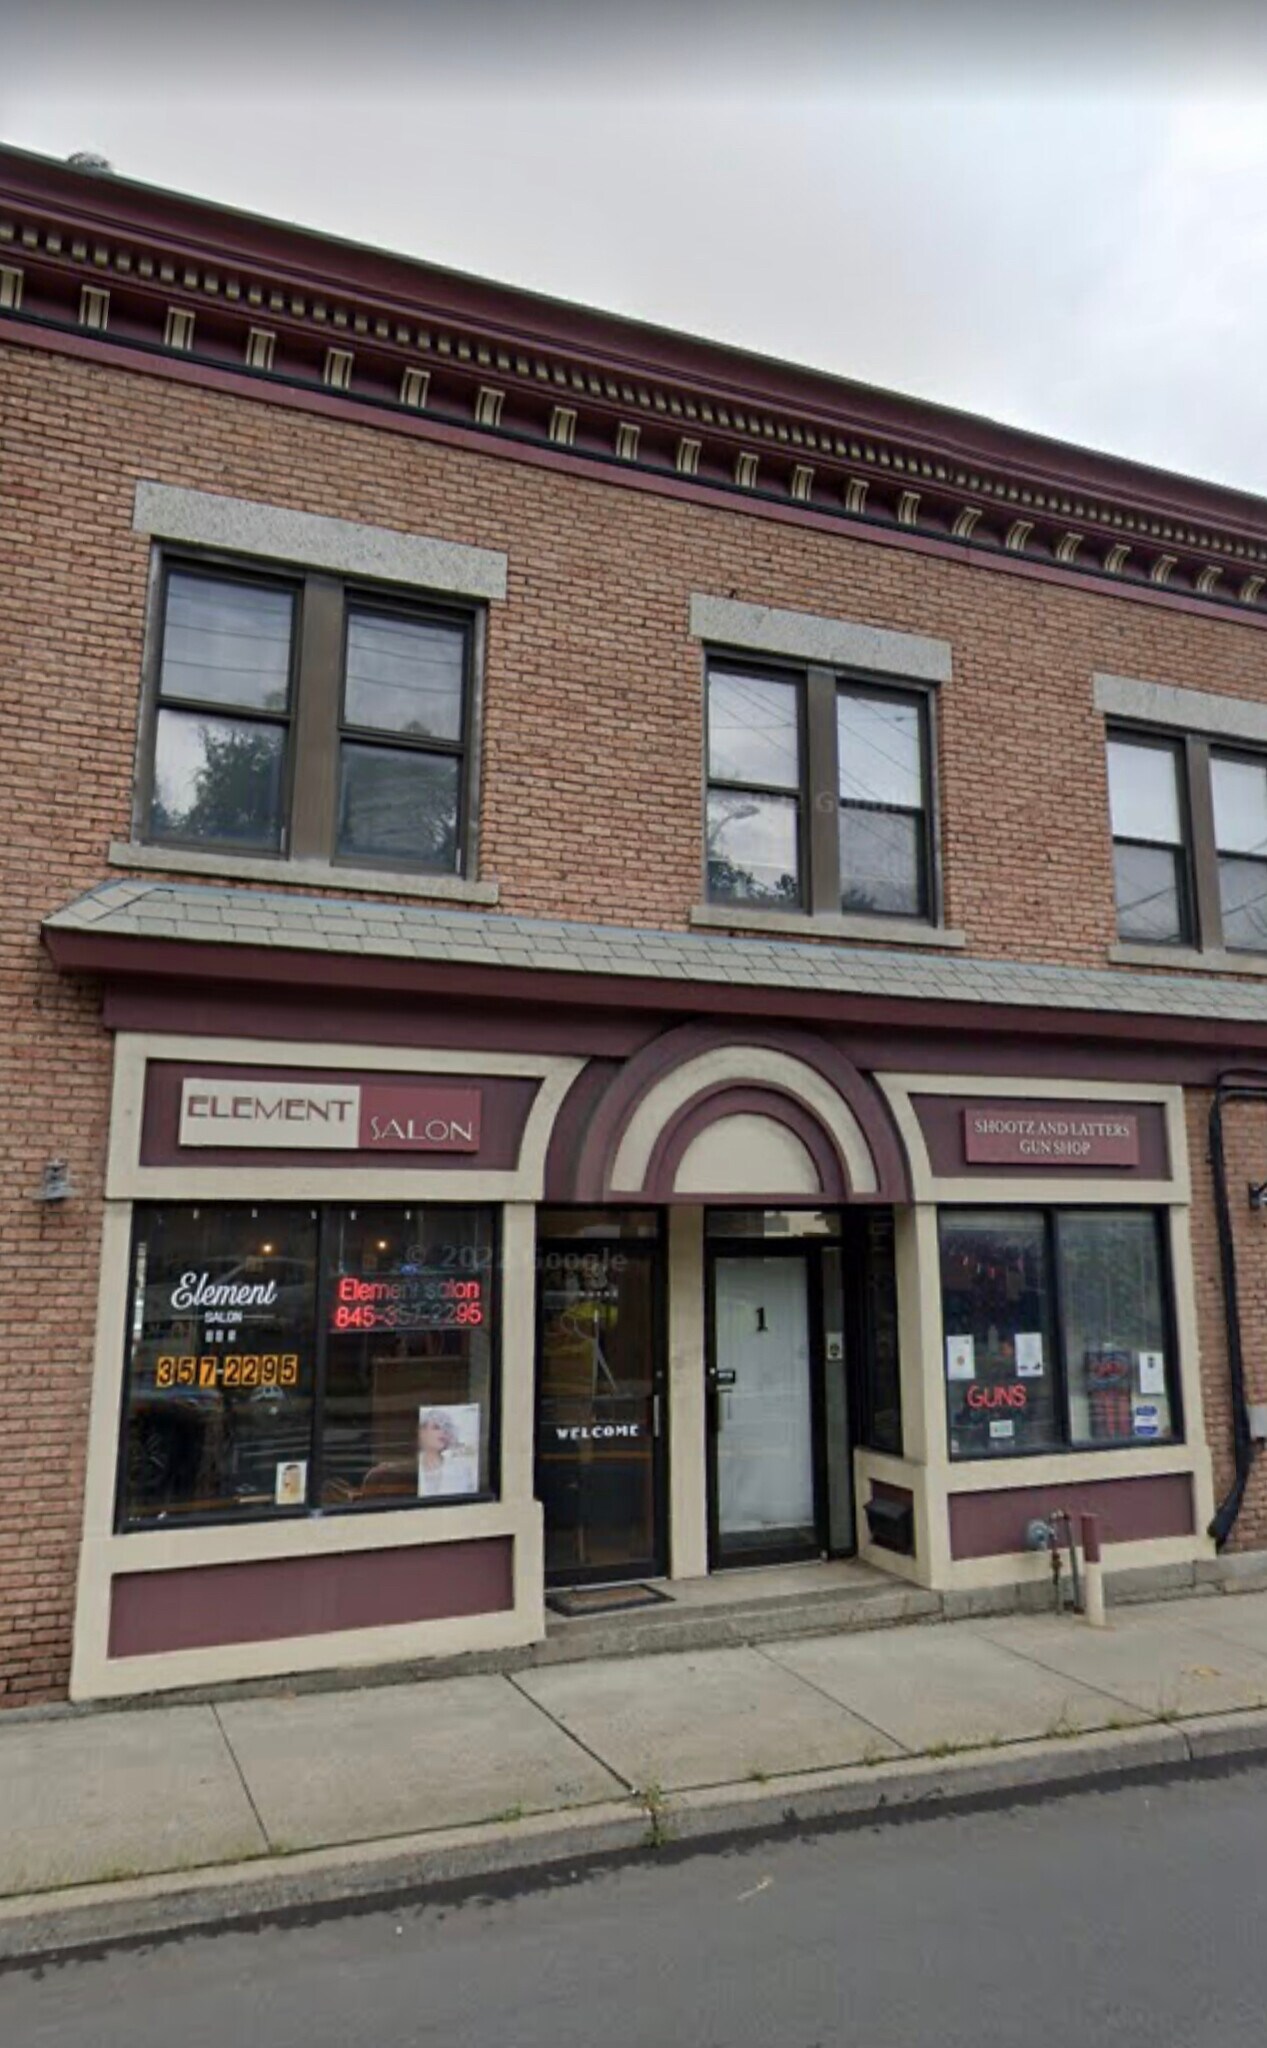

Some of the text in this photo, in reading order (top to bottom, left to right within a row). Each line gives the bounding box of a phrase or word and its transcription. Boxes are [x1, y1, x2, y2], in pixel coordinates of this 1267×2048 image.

[187, 1095, 472, 1141] ELEMENT SALON
[975, 1120, 1130, 1138] SHOOTZ AND LATTERS
[1019, 1139, 1091, 1156] GUN SHOP
[171, 1270, 278, 1311] Element
[339, 1278, 480, 1301] Element salon
[204, 1310, 243, 1324] SALON
[756, 1307, 768, 1332] 1
[156, 1354, 299, 1388] 357-2295
[966, 1384, 1027, 1409] GUNS
[556, 1424, 639, 1440] WELCOME
